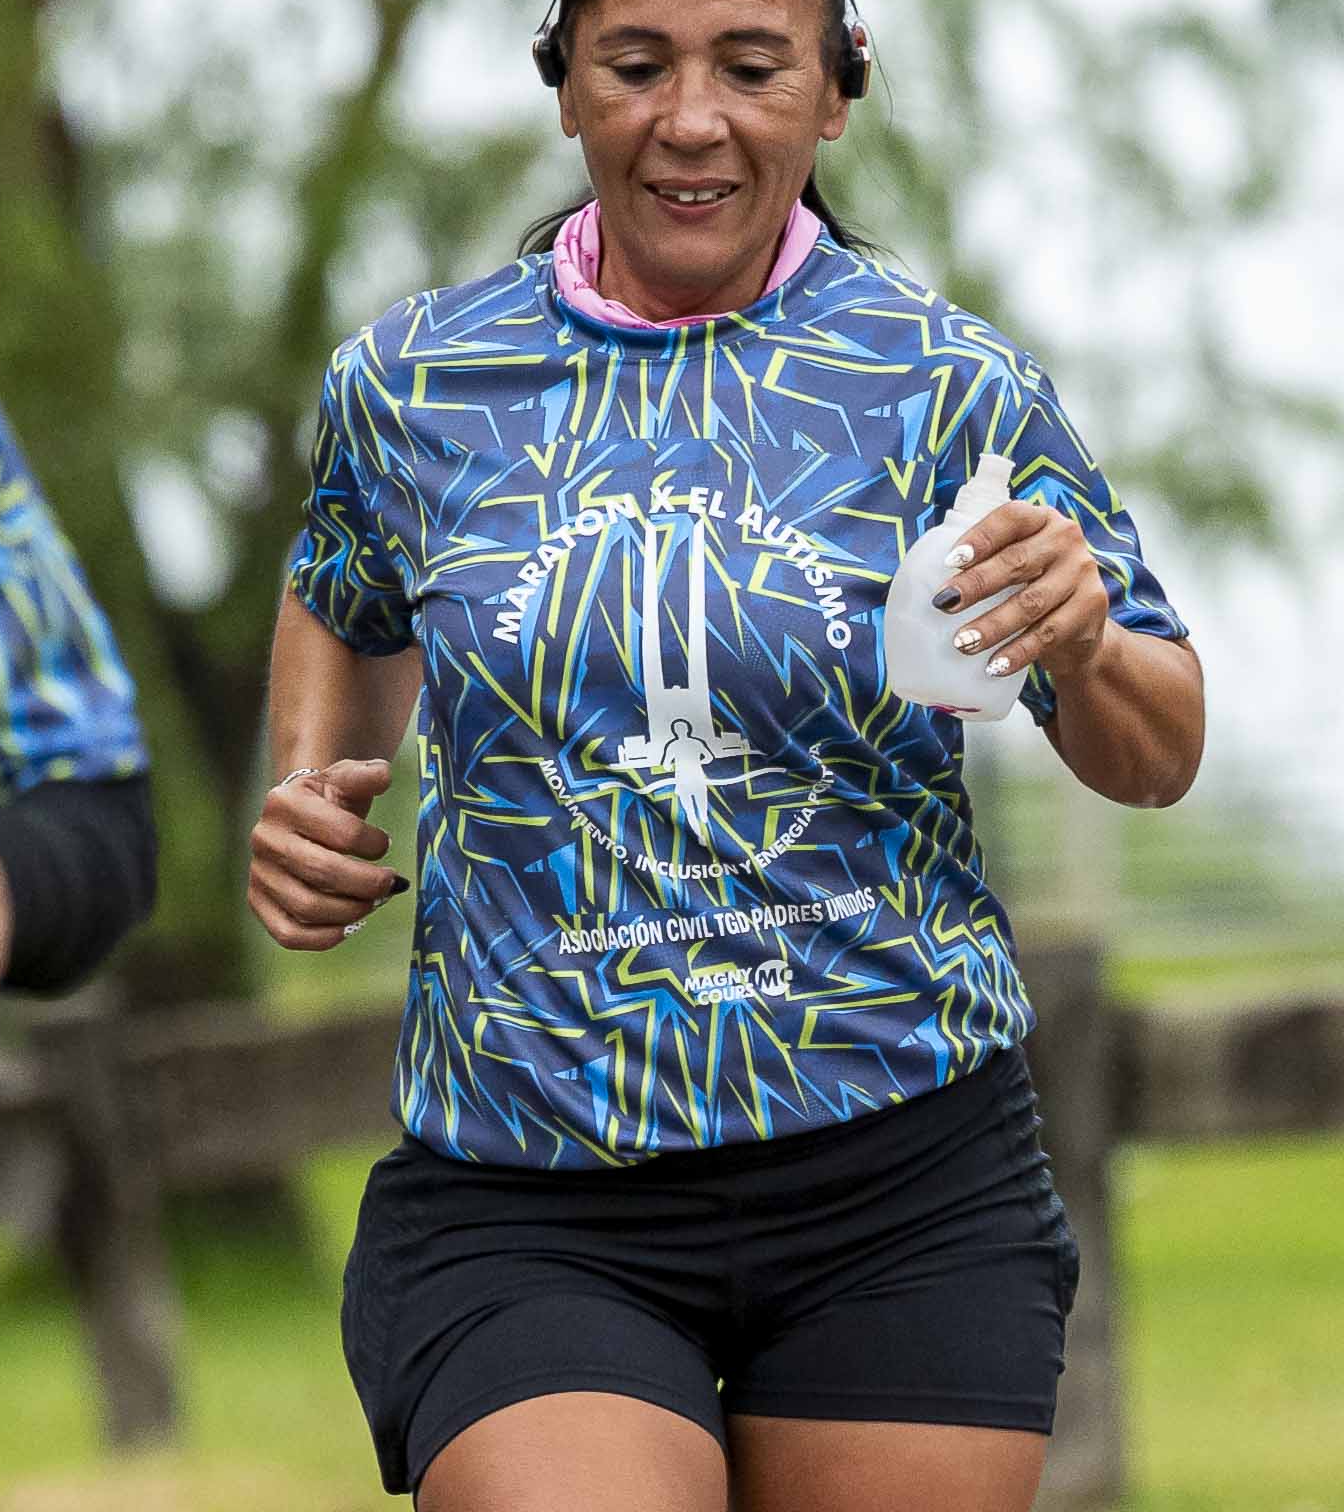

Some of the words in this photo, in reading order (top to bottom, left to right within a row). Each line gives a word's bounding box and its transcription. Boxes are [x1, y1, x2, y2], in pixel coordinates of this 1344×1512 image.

[649, 487, 675, 514] X
[688, 487, 727, 519] EL
[735, 503, 852, 650] AUTISMO
[739, 859, 753, 875] Y
[755, 807, 817, 869] ENERGÍA
[558, 914, 664, 955] ASOCIACIÓN
[666, 916, 714, 942] CIVIL
[713, 911, 751, 937] TGD
[751, 902, 824, 930] PADRES
[824, 887, 876, 922] UNIDOS
[684, 967, 753, 992] MAGNY
[697, 983, 754, 1005] COURS
